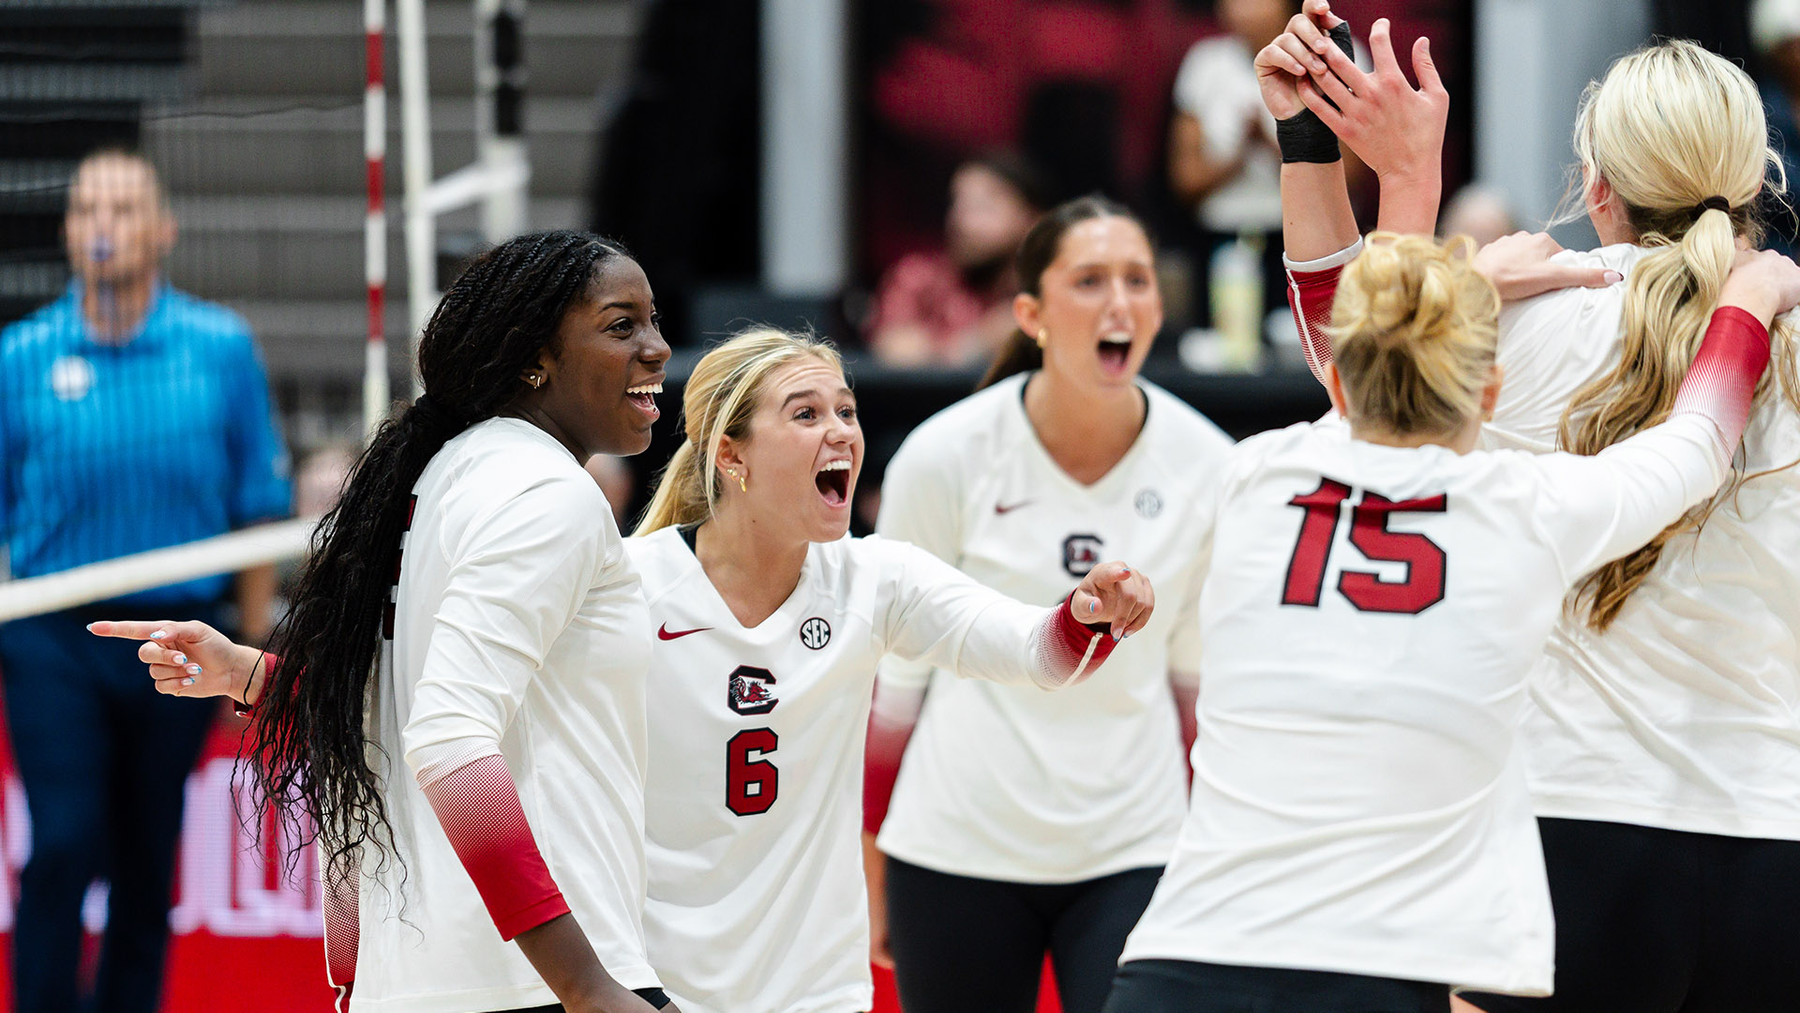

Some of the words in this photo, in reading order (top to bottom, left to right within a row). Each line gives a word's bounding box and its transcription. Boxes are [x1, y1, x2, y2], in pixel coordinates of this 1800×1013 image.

[1281, 476, 1447, 614] 15
[801, 619, 830, 648] SEC
[726, 727, 779, 816] 6
